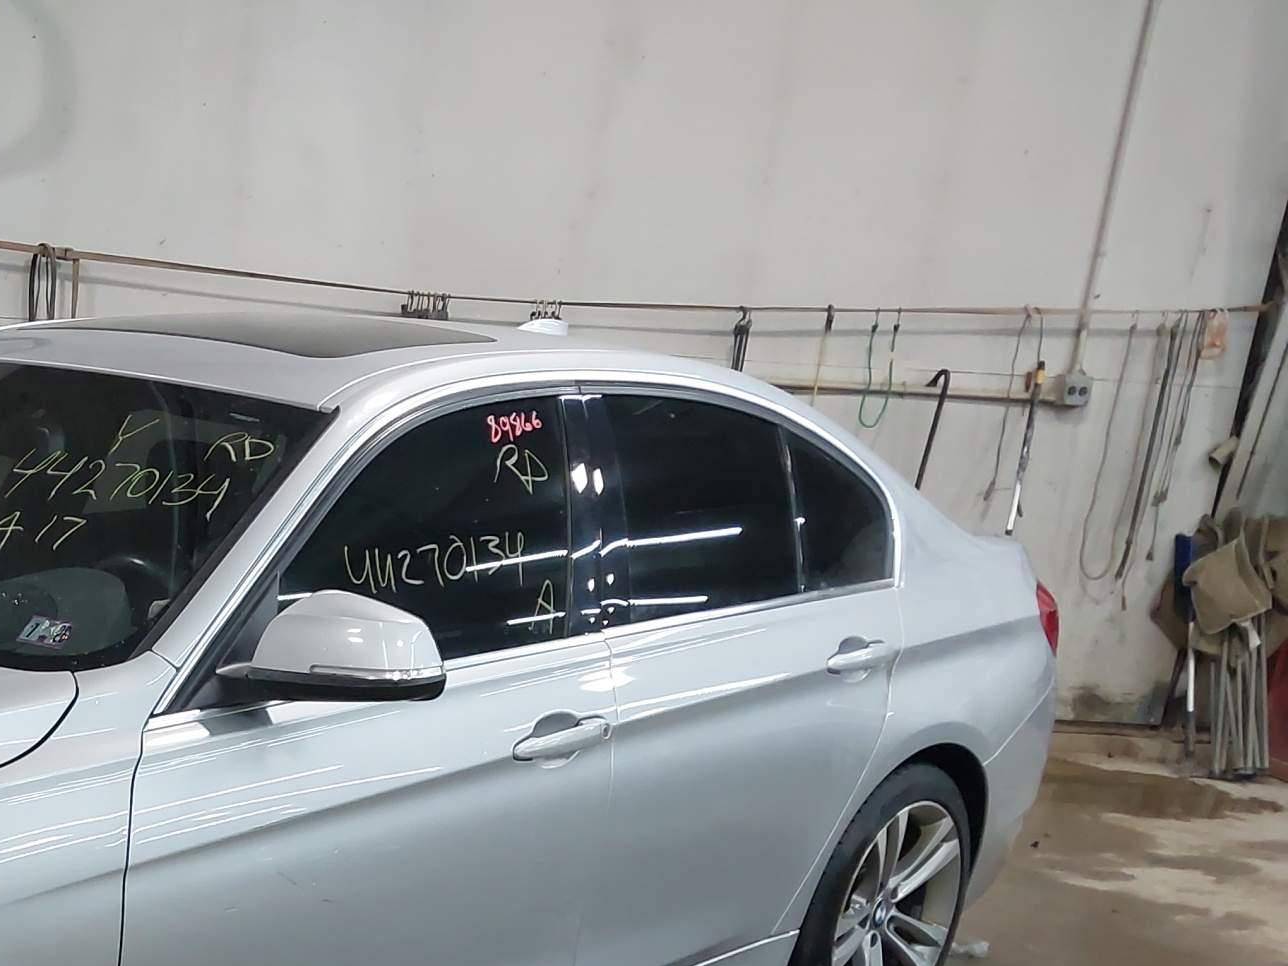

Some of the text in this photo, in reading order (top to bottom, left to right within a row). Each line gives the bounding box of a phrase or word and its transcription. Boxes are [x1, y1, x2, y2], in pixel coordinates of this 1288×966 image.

[5, 448, 231, 521] 44270134
[344, 531, 525, 594] 44270134
[527, 579, 556, 634] A
